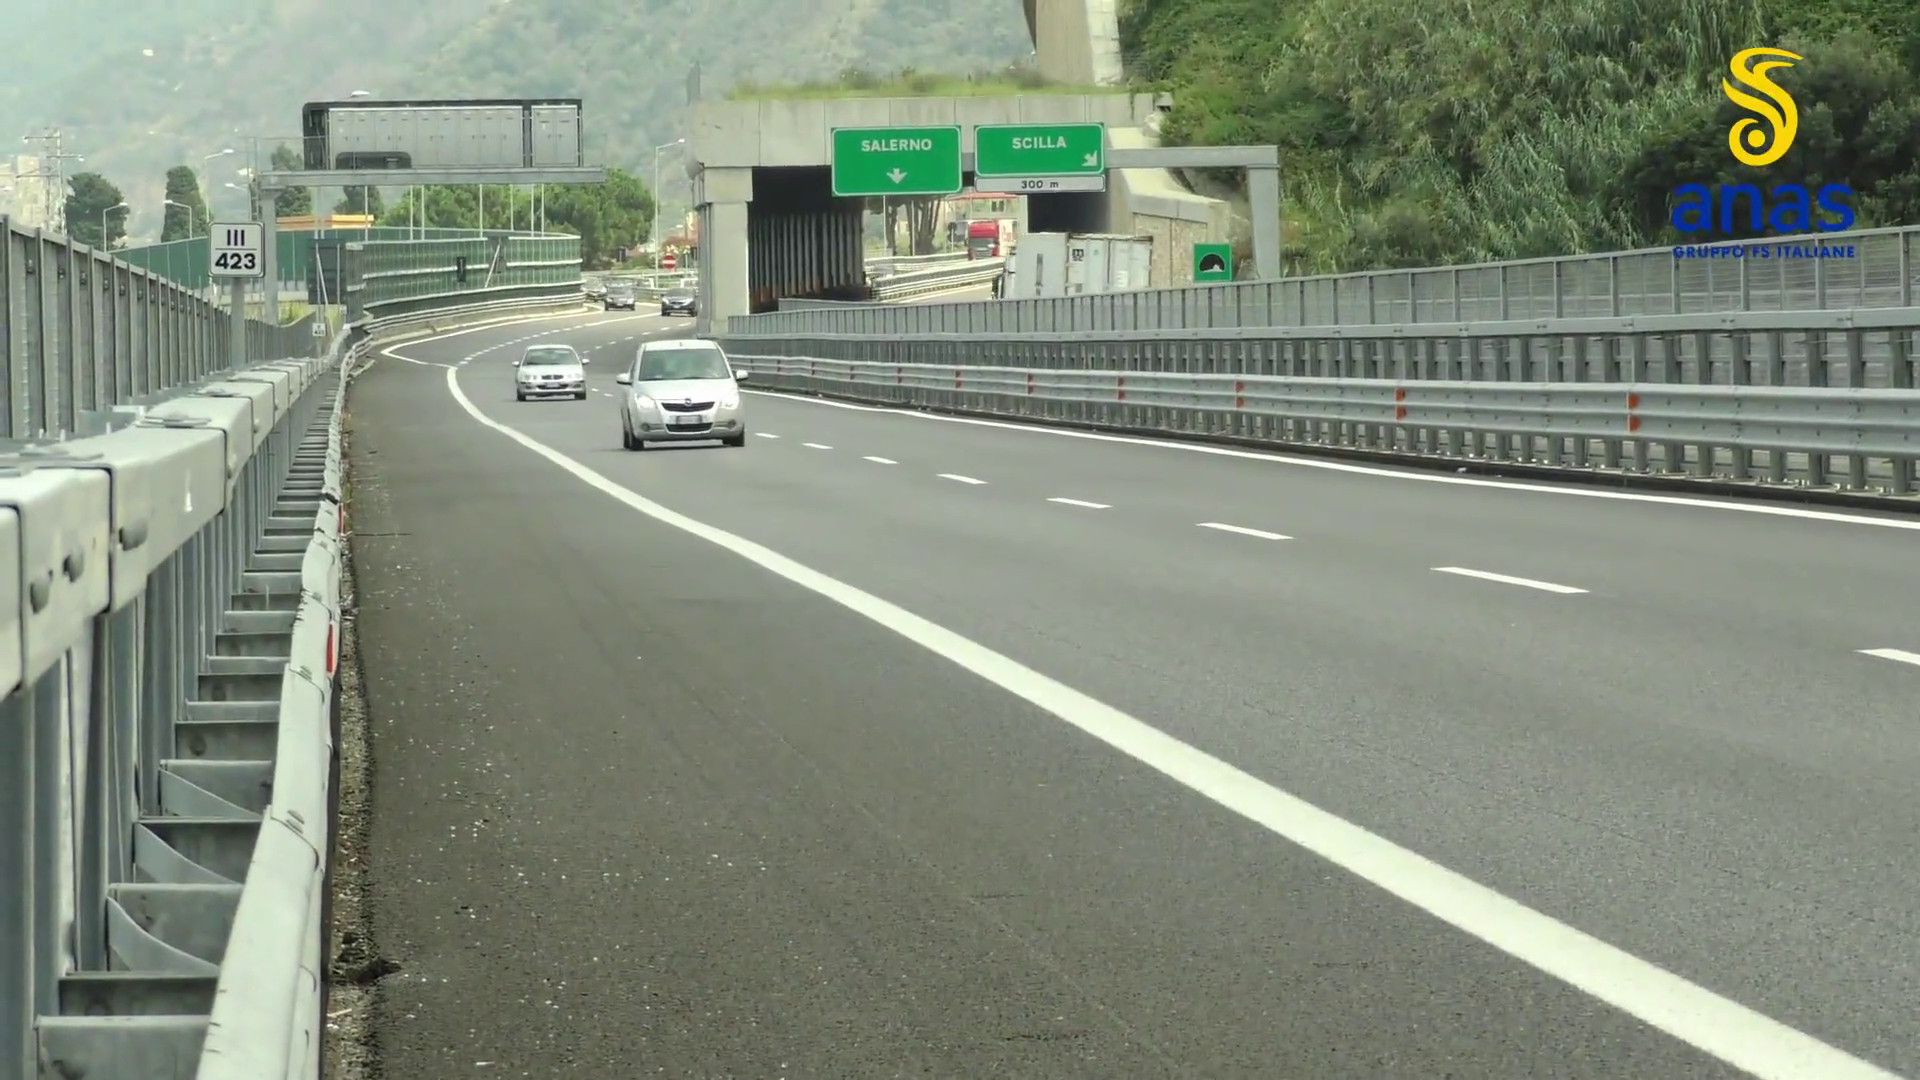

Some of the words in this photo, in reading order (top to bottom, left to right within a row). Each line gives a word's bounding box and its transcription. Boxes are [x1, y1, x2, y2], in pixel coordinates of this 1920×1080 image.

[861, 139, 932, 152] SALERNO
[1012, 136, 1067, 149] SCILLA
[1021, 180, 1043, 189] 300
[227, 229, 245, 246] III
[215, 253, 256, 269] 423
